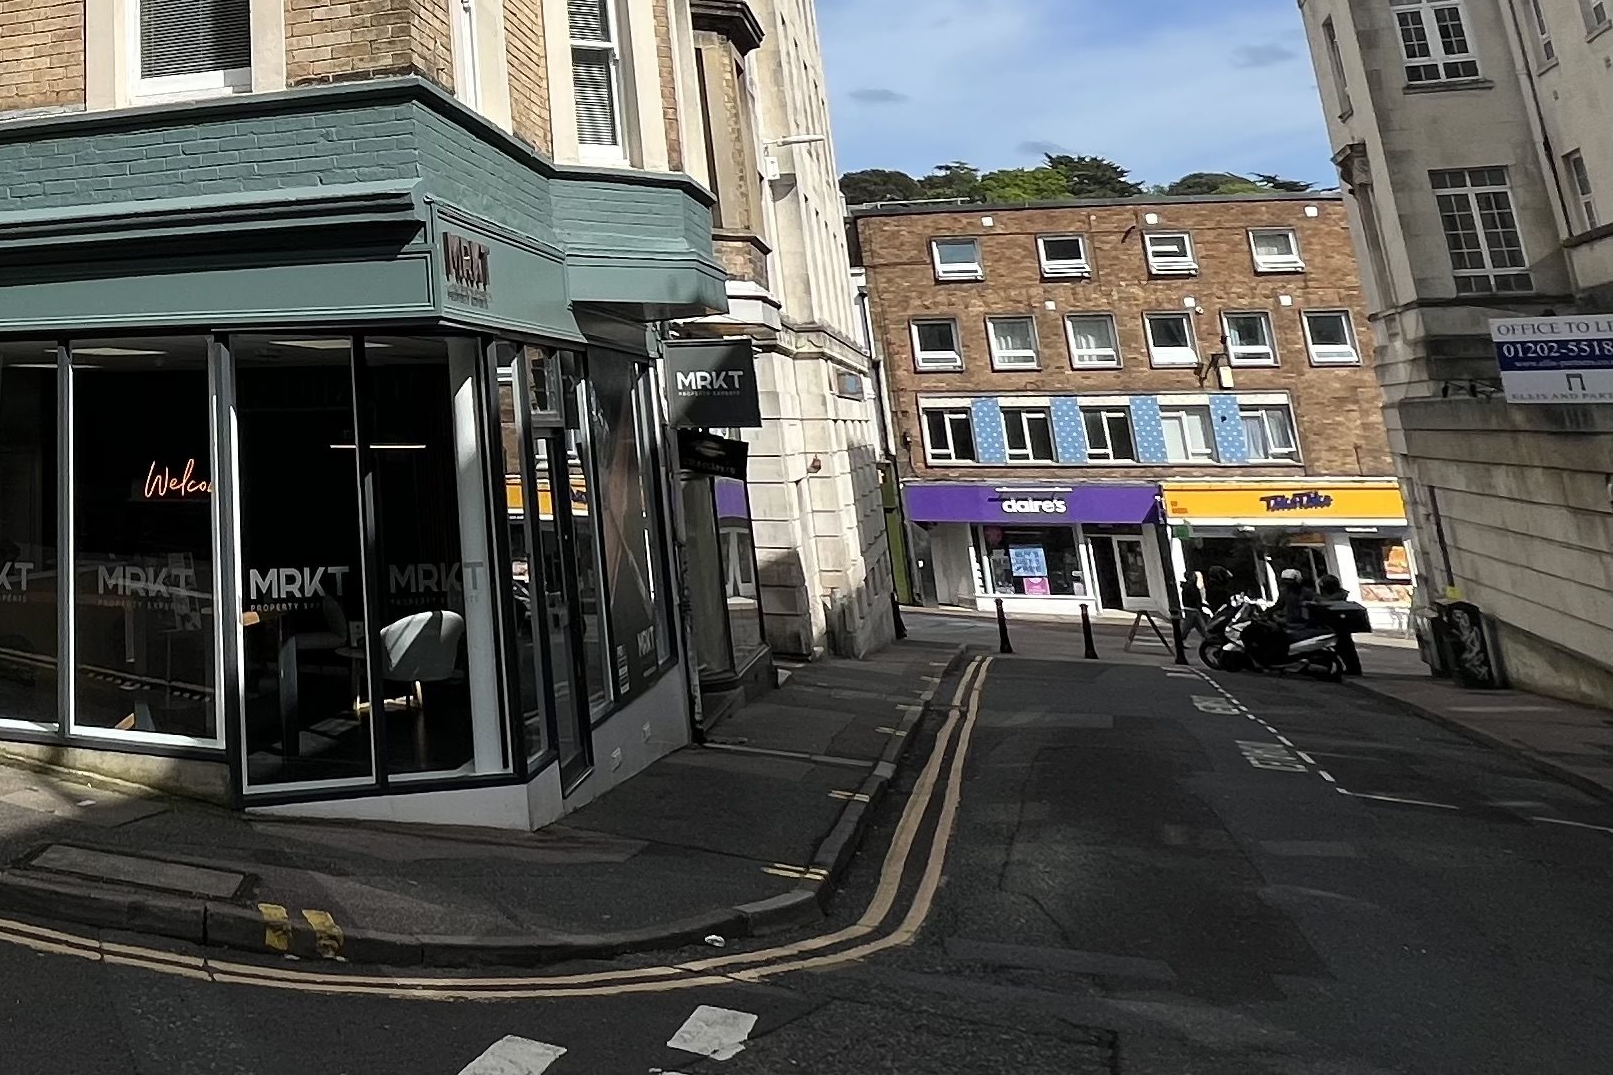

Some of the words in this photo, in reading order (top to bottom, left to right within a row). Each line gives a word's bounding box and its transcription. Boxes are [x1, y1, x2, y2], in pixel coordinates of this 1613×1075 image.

[1498, 323, 1561, 335] OFFICE
[1565, 321, 1590, 334] TO
[676, 370, 744, 390] MRKT
[144, 458, 212, 498] Welco
[98, 564, 194, 597] MRKT
[249, 565, 350, 600] MRKT
[388, 561, 484, 594] MRKT
[250, 602, 299, 612] PROPERTY
